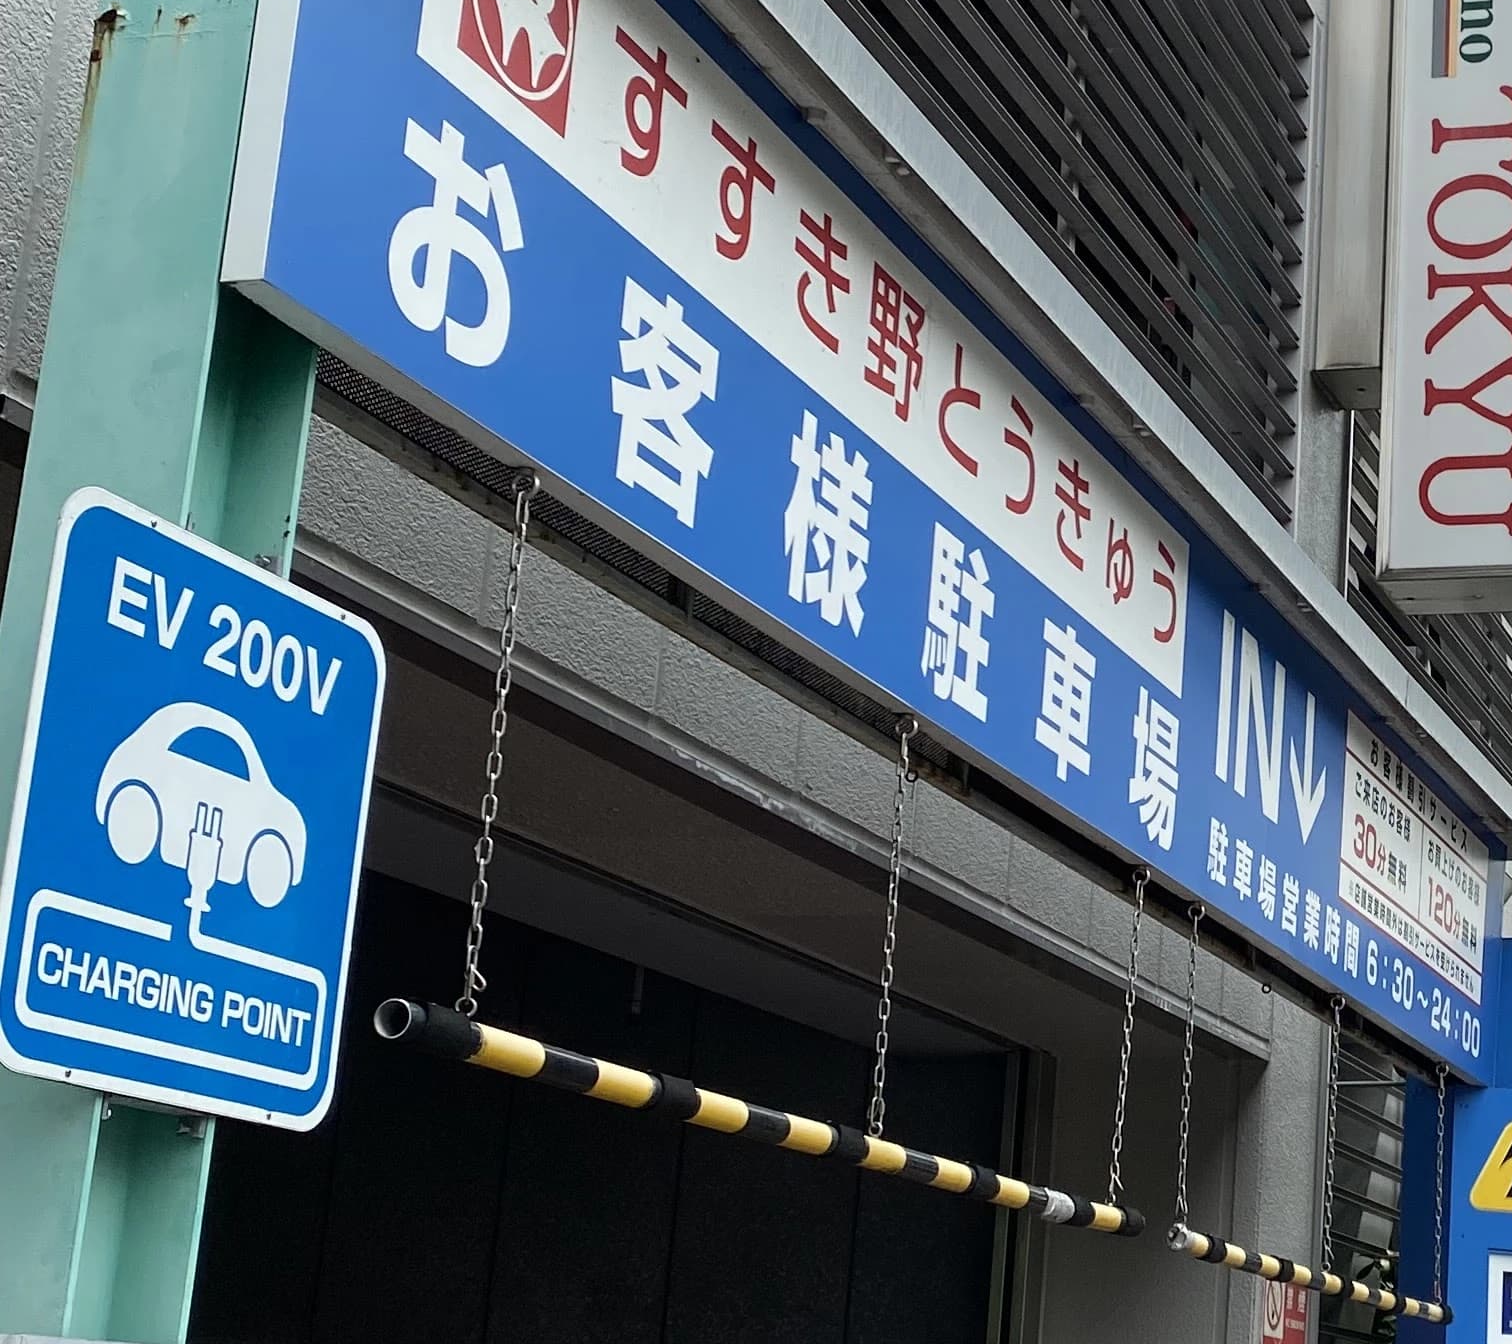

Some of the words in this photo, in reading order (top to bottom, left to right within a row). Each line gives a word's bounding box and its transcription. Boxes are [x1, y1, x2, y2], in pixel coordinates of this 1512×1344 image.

[615, 24, 1179, 644] すすき野とうきゅう
[388, 116, 1181, 852] お客様駐車場
[106, 556, 195, 650] EV
[203, 603, 342, 715] 200V
[1214, 609, 1286, 825] IN
[1355, 771, 1411, 843] ご来店のお客様
[1370, 739, 1468, 853] お客様割引サービス
[1353, 813, 1408, 896] 30分無料
[1427, 877, 1478, 955] 120分無料
[36, 942, 214, 1023] CHARGING
[220, 990, 312, 1048] POINT
